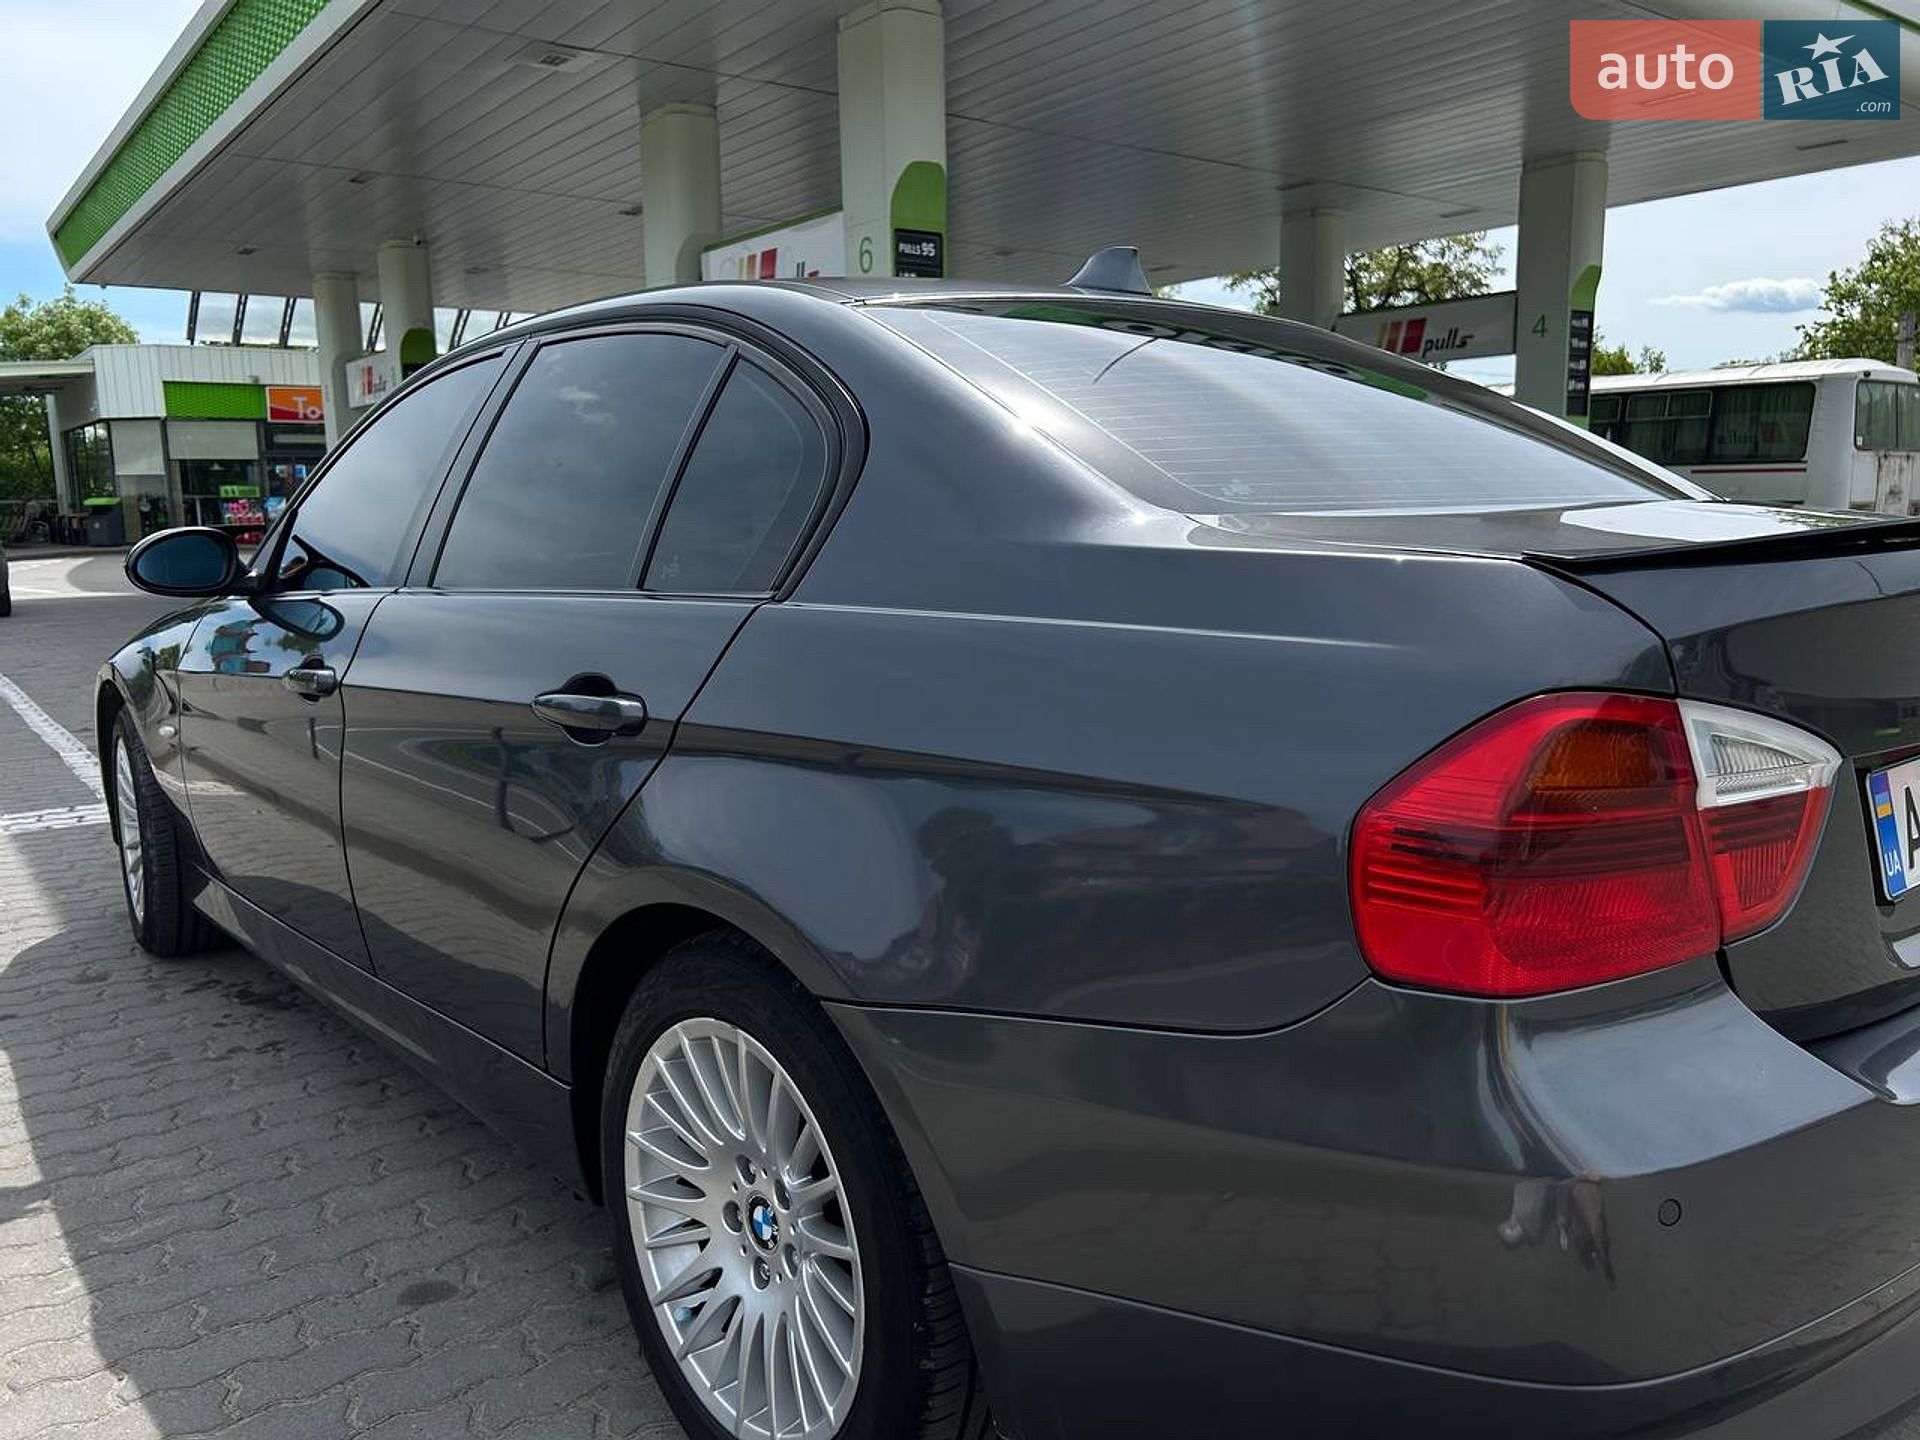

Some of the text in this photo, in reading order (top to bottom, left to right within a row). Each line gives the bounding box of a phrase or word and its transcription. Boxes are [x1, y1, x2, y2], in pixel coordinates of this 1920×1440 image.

[859, 238, 872, 273] 6
[1531, 314, 1548, 338] 4
[1421, 327, 1475, 359] pulls
[1884, 849, 1902, 877] UA
